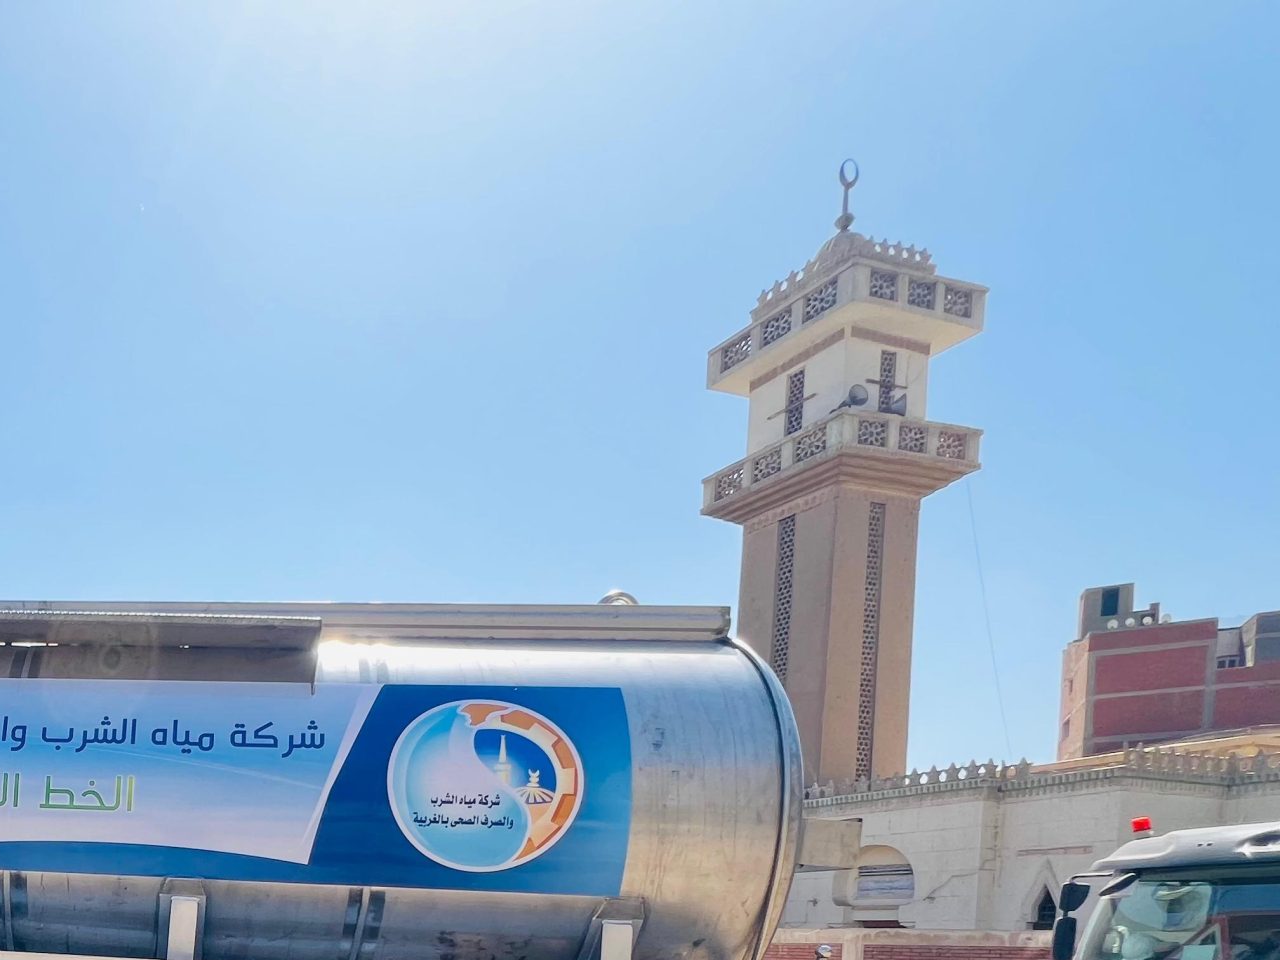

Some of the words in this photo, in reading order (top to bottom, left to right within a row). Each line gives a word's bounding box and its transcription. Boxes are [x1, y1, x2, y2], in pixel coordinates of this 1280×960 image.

[41, 715, 137, 753] الشرب
[150, 719, 215, 754] مياه
[229, 720, 326, 758] شركة
[39, 775, 135, 813] الخط
[430, 792, 458, 807] الشرب
[459, 794, 476, 809] مياه
[478, 793, 500, 809] شركة
[413, 811, 449, 828] بالغربية
[480, 814, 514, 829] والصرف
